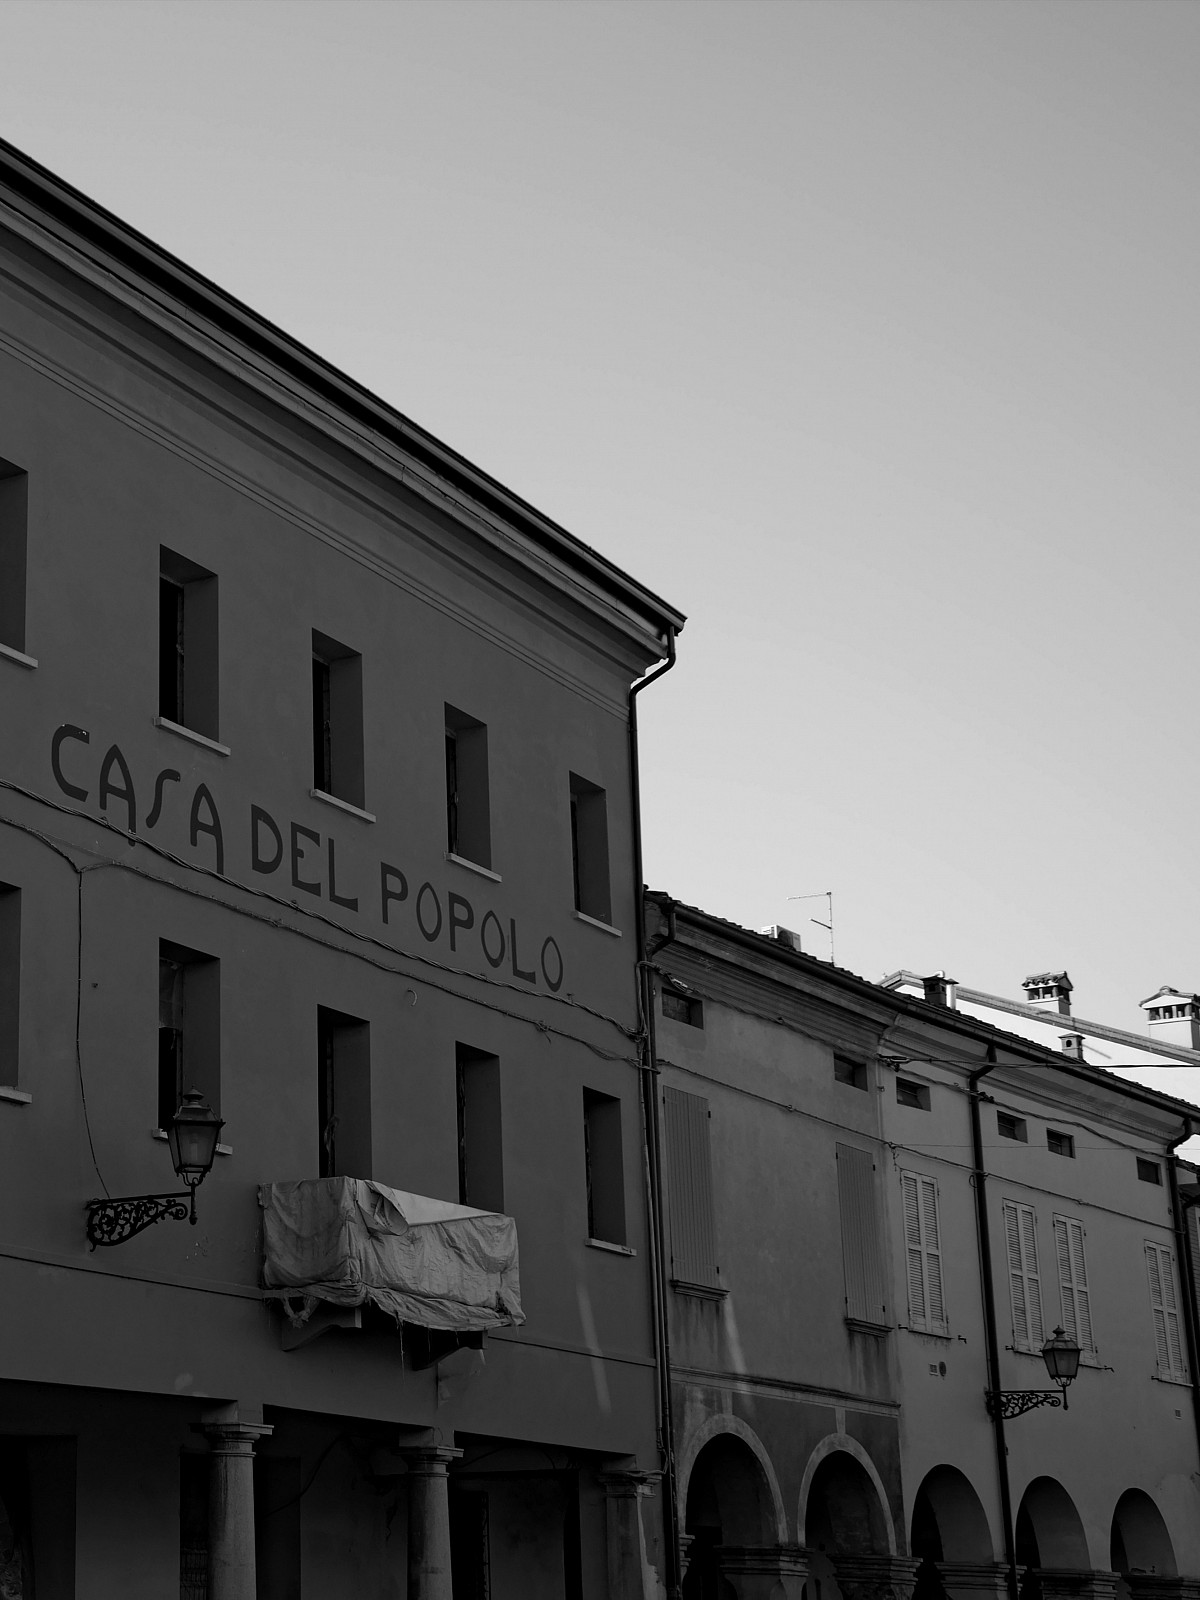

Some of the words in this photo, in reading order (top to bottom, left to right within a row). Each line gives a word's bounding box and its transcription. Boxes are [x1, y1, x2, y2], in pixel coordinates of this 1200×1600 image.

[51, 723, 224, 875] CASA
[251, 803, 359, 912] DEL
[380, 861, 564, 992] POPOLO
